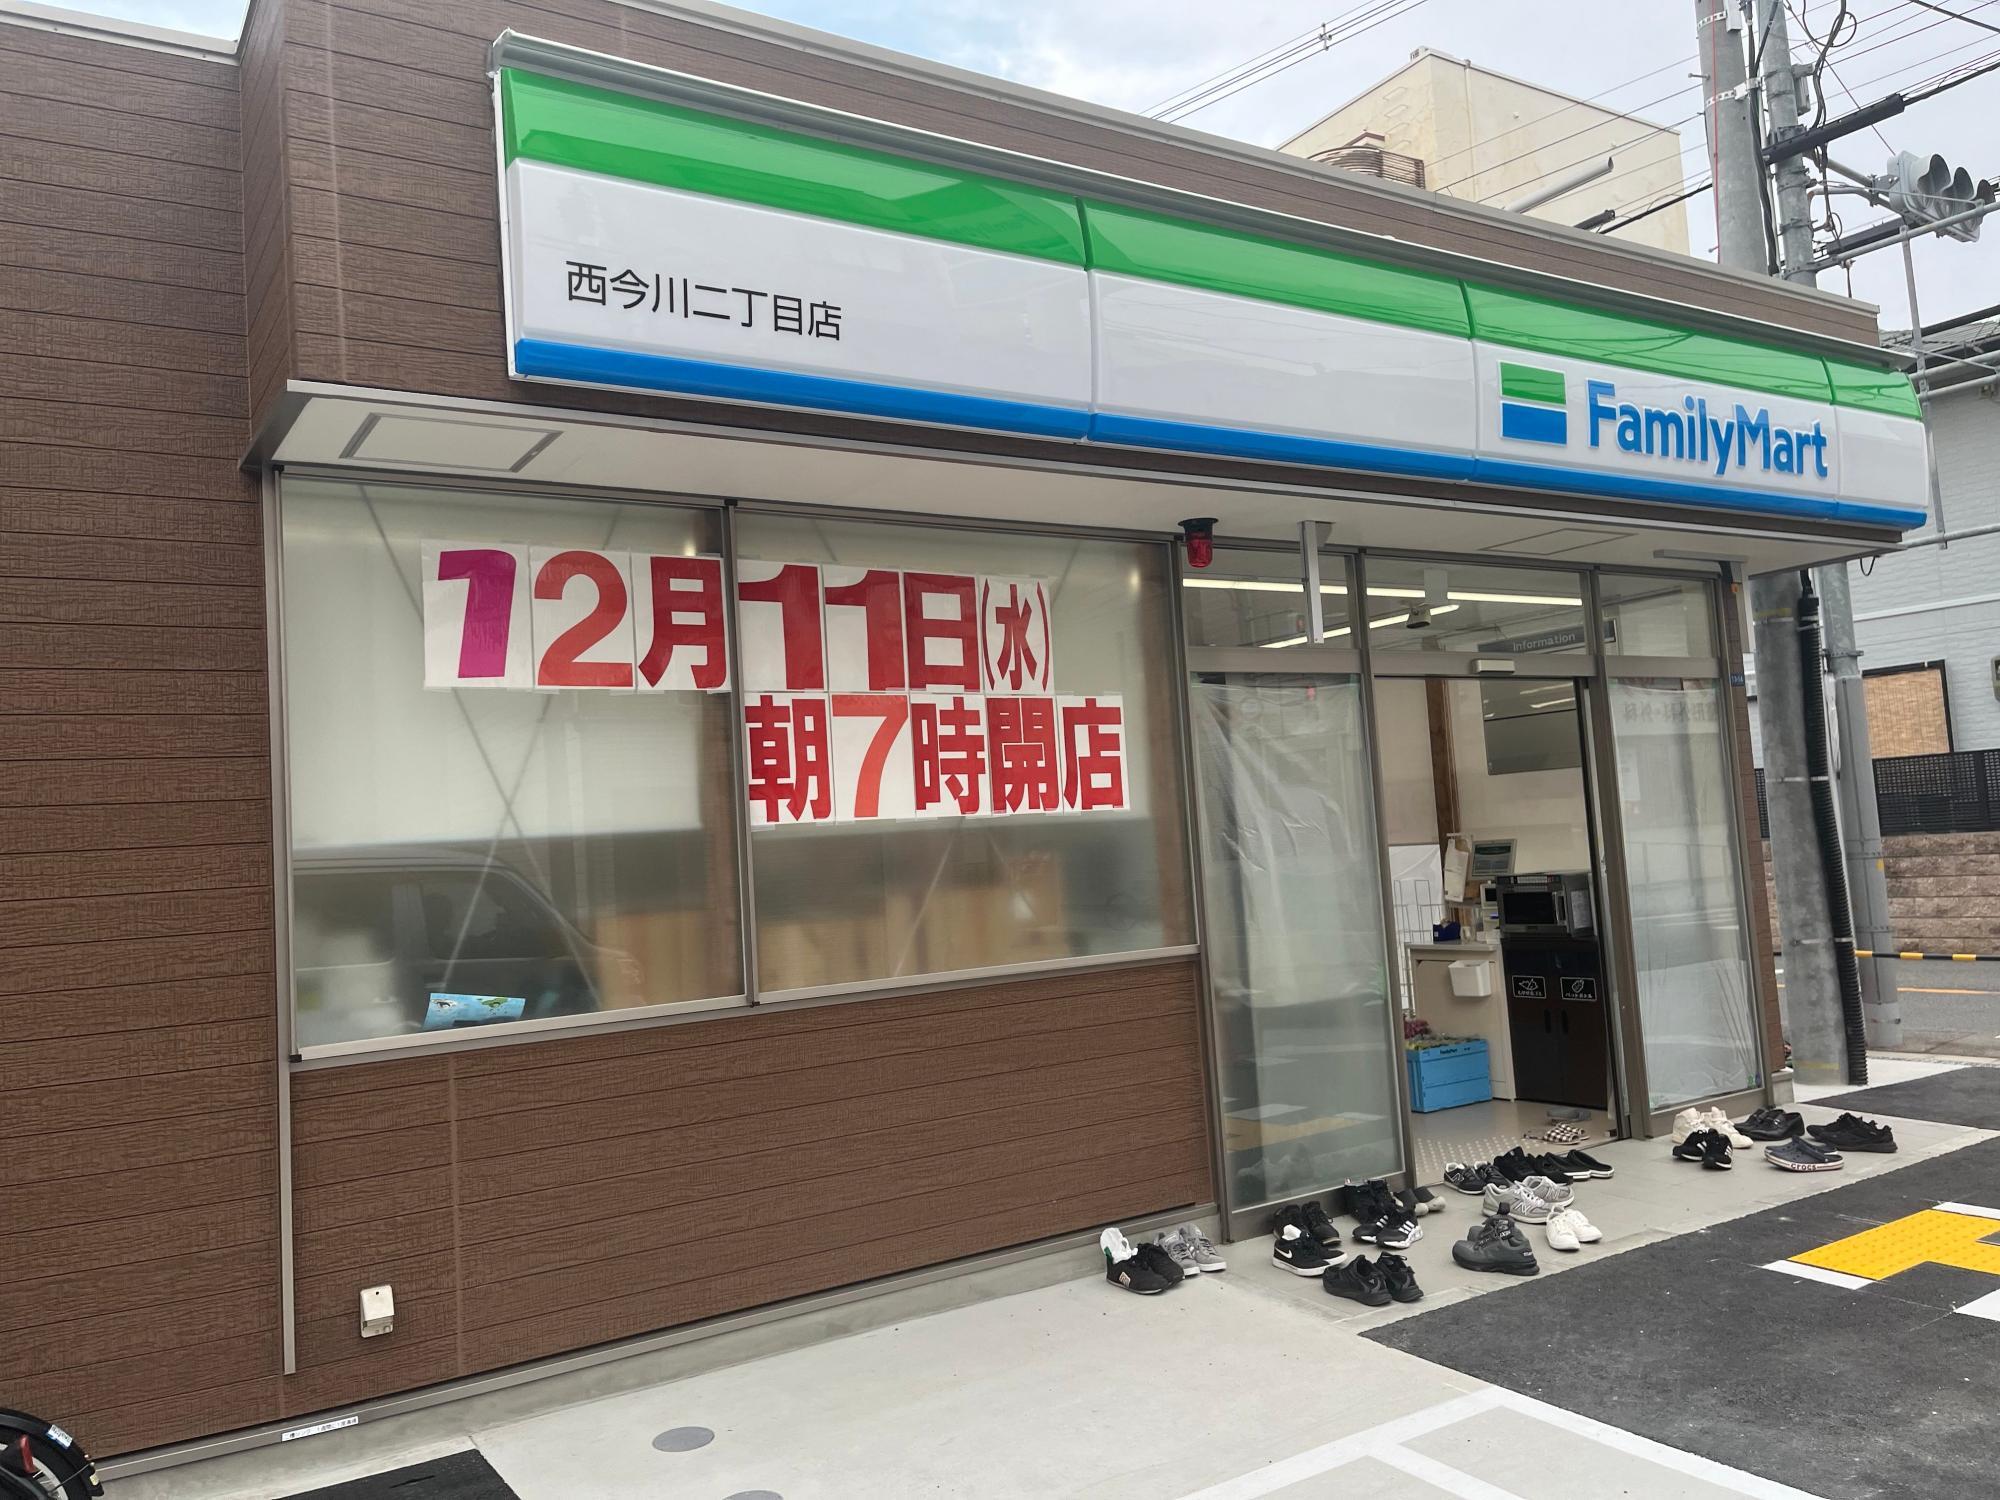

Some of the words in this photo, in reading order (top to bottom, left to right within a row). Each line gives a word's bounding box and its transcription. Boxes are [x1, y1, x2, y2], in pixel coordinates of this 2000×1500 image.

[566, 261, 843, 342] 西今川二丁目店
[1588, 379, 1828, 478] FamilyMart
[437, 549, 1050, 692] 12月11日(水)
[746, 695, 1123, 823] 朝7時開店
[1790, 1163, 1817, 1172] crocs
